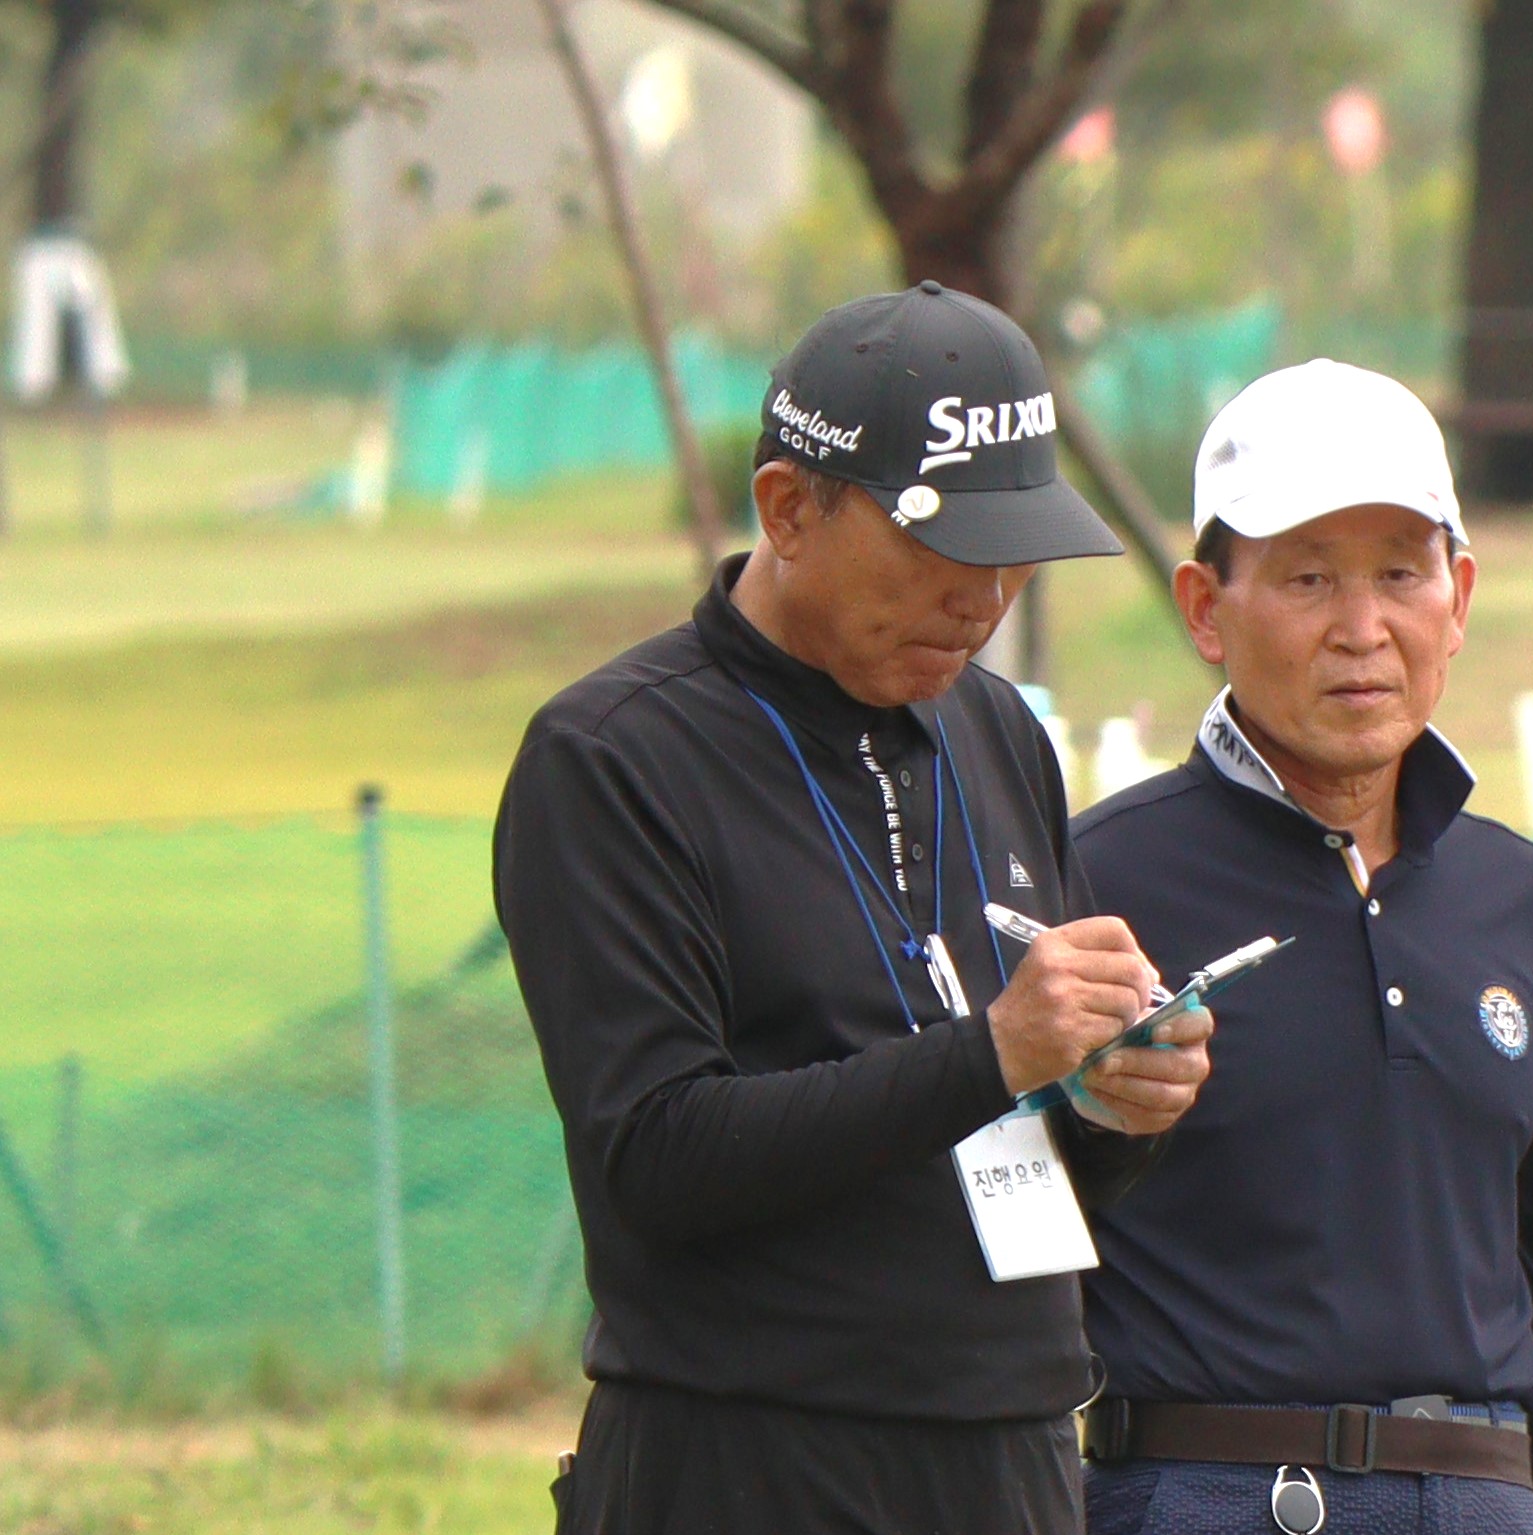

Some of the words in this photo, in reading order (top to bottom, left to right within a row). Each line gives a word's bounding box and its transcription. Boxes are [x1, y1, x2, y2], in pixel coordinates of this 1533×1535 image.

[772, 388, 863, 452] Cleveland
[779, 426, 832, 461] GOLF
[886, 812, 902, 830] BE
[889, 832, 904, 864] WITH
